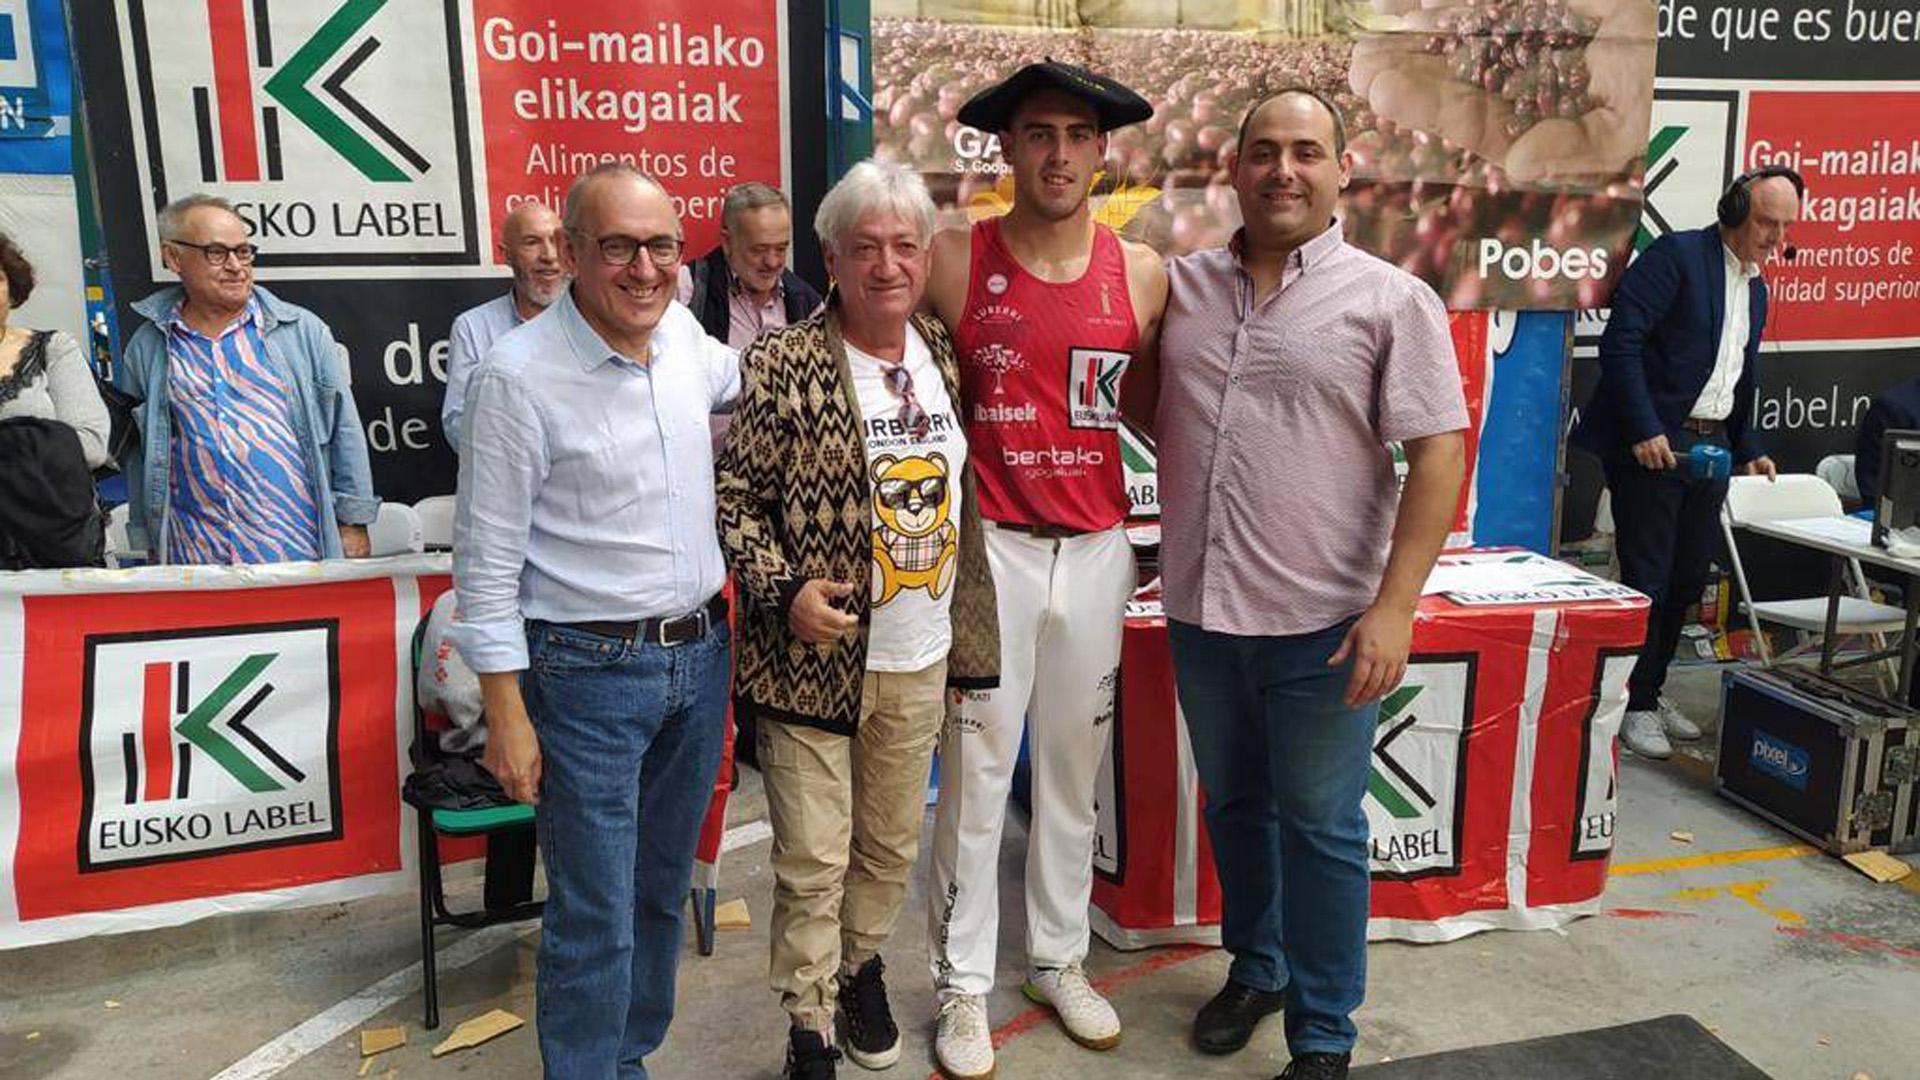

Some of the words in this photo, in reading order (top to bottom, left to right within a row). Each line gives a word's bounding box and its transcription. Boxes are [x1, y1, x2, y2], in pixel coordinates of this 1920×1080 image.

[483, 17, 764, 69] Goi-mailako
[1657, 0, 1698, 38] de
[1711, 6, 1780, 52] que
[1793, 8, 1832, 41] es
[514, 78, 743, 133] elikagaiak
[699, 146, 737, 177] de
[332, 202, 457, 238] LABEL
[1478, 238, 1609, 280] Pobes
[1887, 239, 1914, 265] de
[1767, 275, 1827, 302] lidad
[367, 406, 431, 452] de
[1002, 444, 1104, 466] bertako
[99, 812, 213, 850] EUSKO
[224, 800, 326, 836] LABEL
[1371, 828, 1448, 862] LABEL
